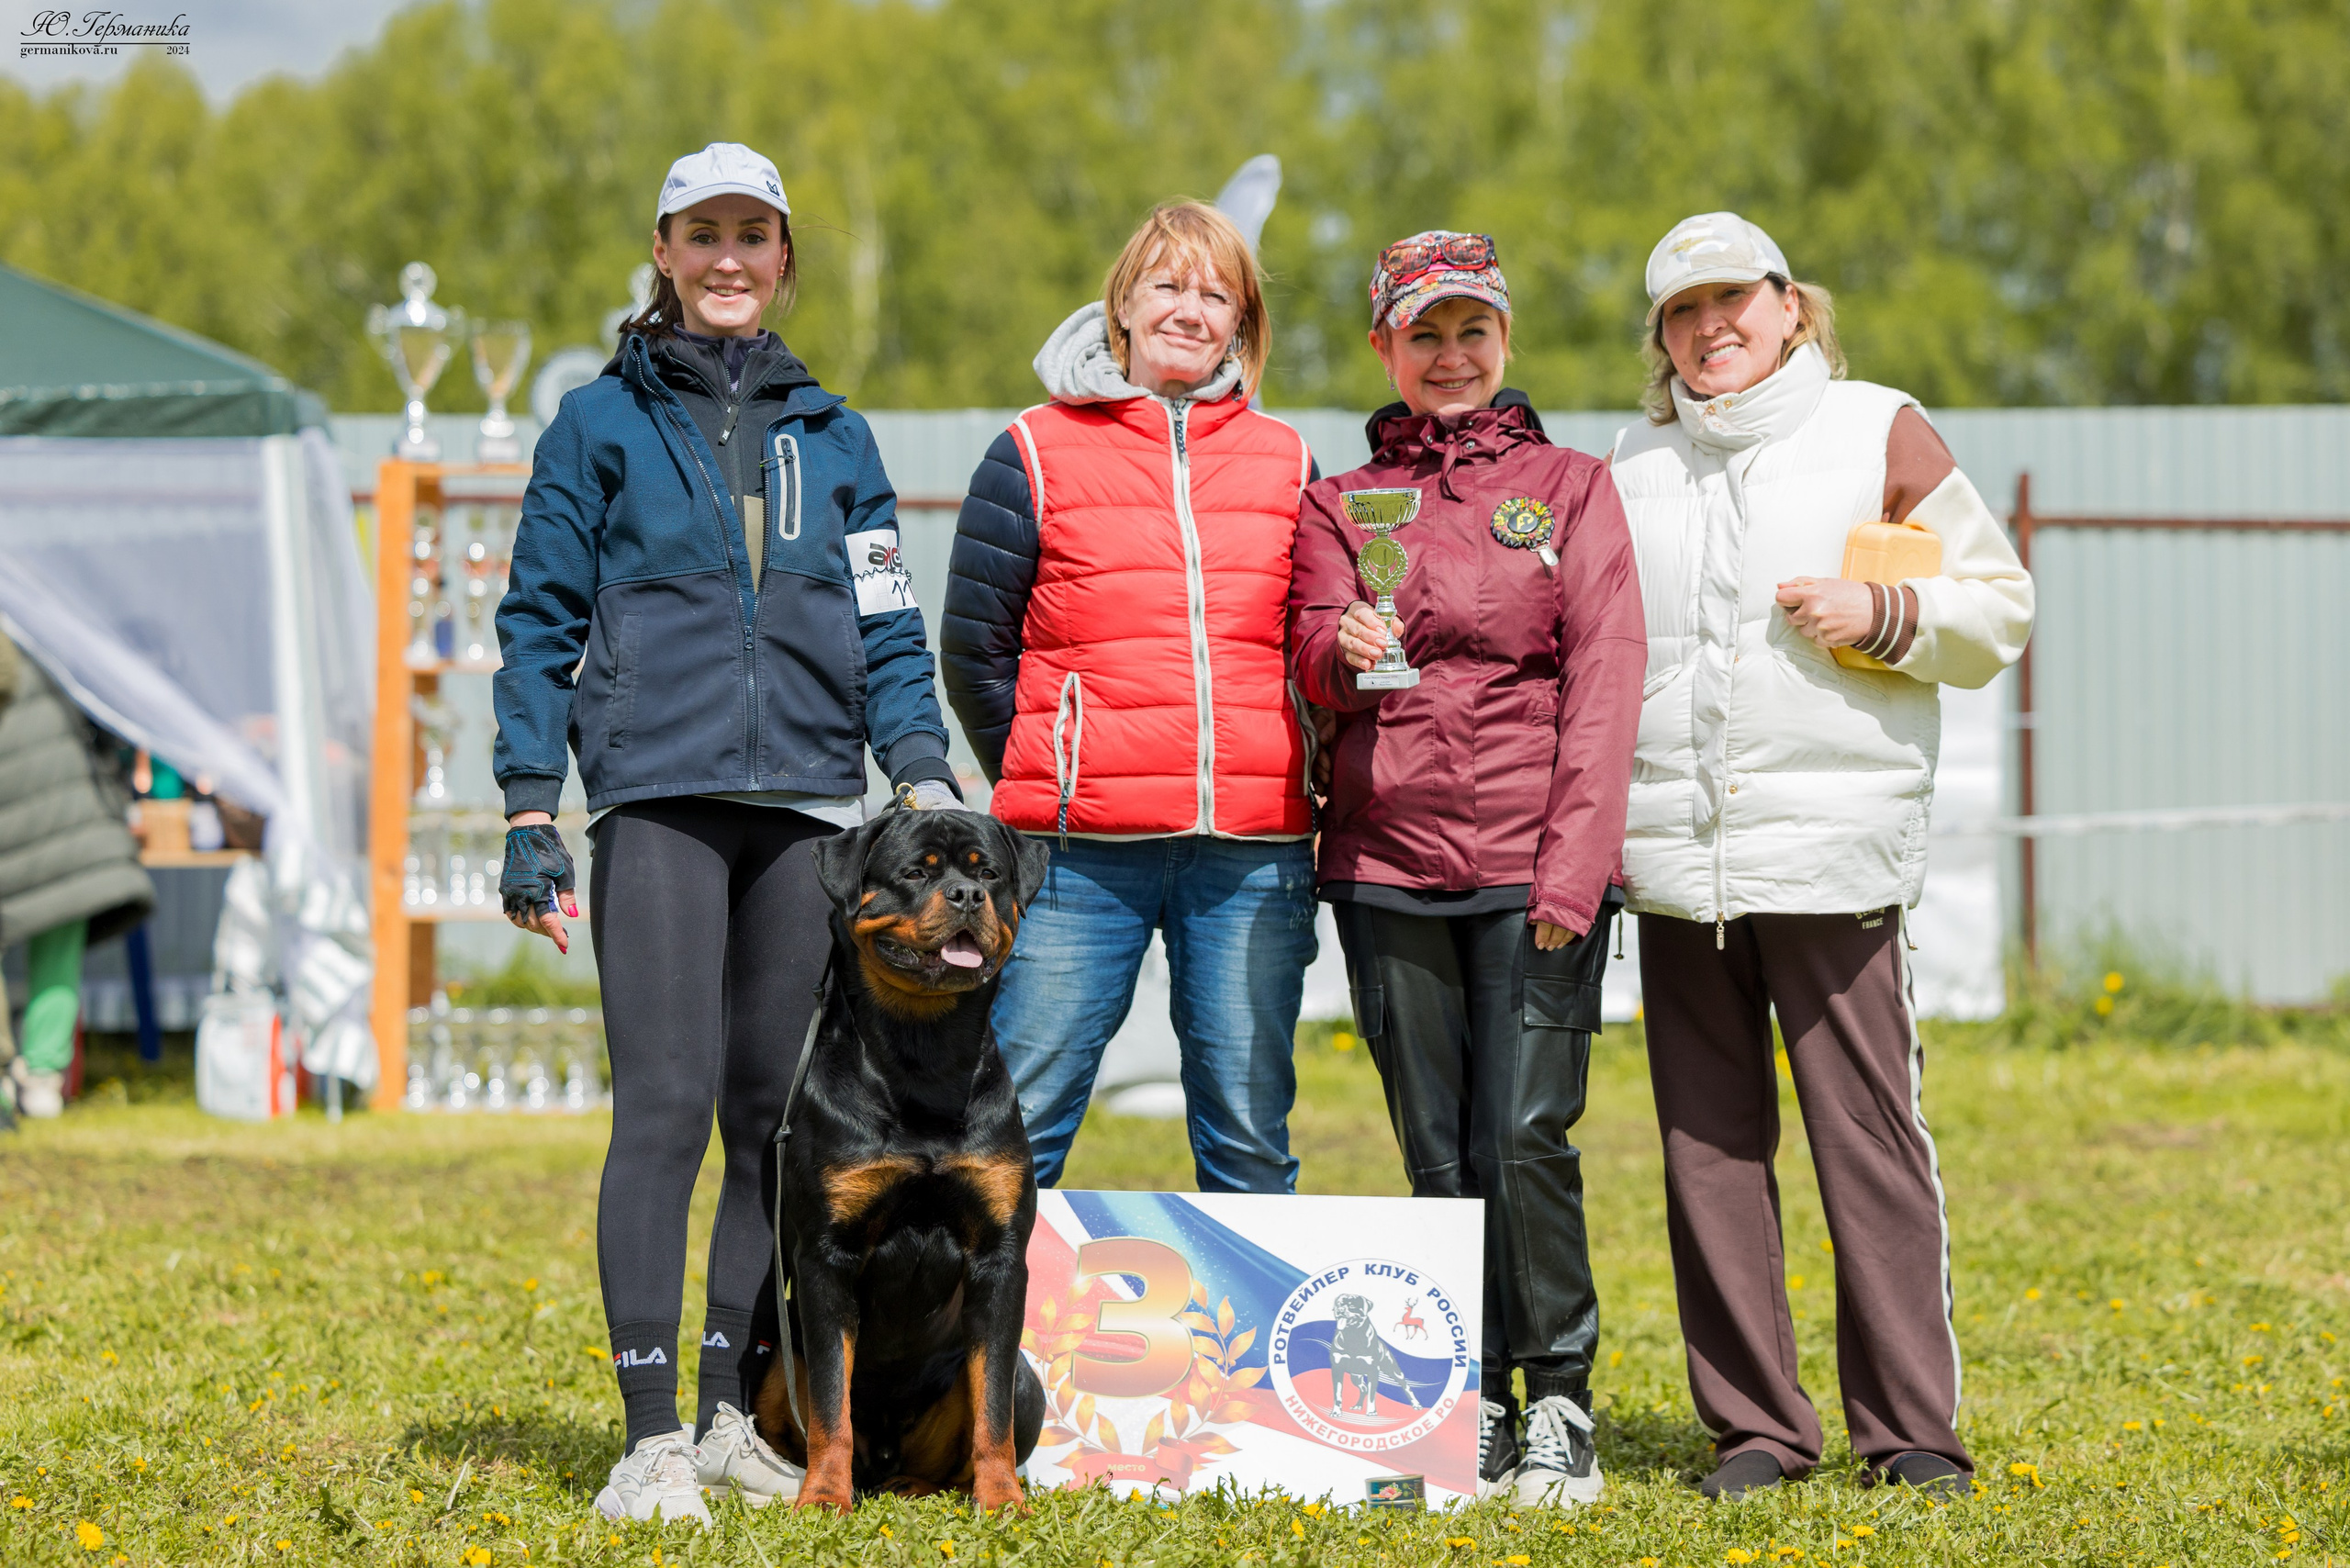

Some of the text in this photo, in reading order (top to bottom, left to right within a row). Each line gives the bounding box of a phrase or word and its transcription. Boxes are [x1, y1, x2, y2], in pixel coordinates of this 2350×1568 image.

[1070, 1236, 1194, 1399] 3
[1273, 1263, 1467, 1368] РОТВЕЙЛЕР КЛУБ РОССИИ
[1284, 1394, 1455, 1450] НИЖЕГОРОДСКОЕ РО
